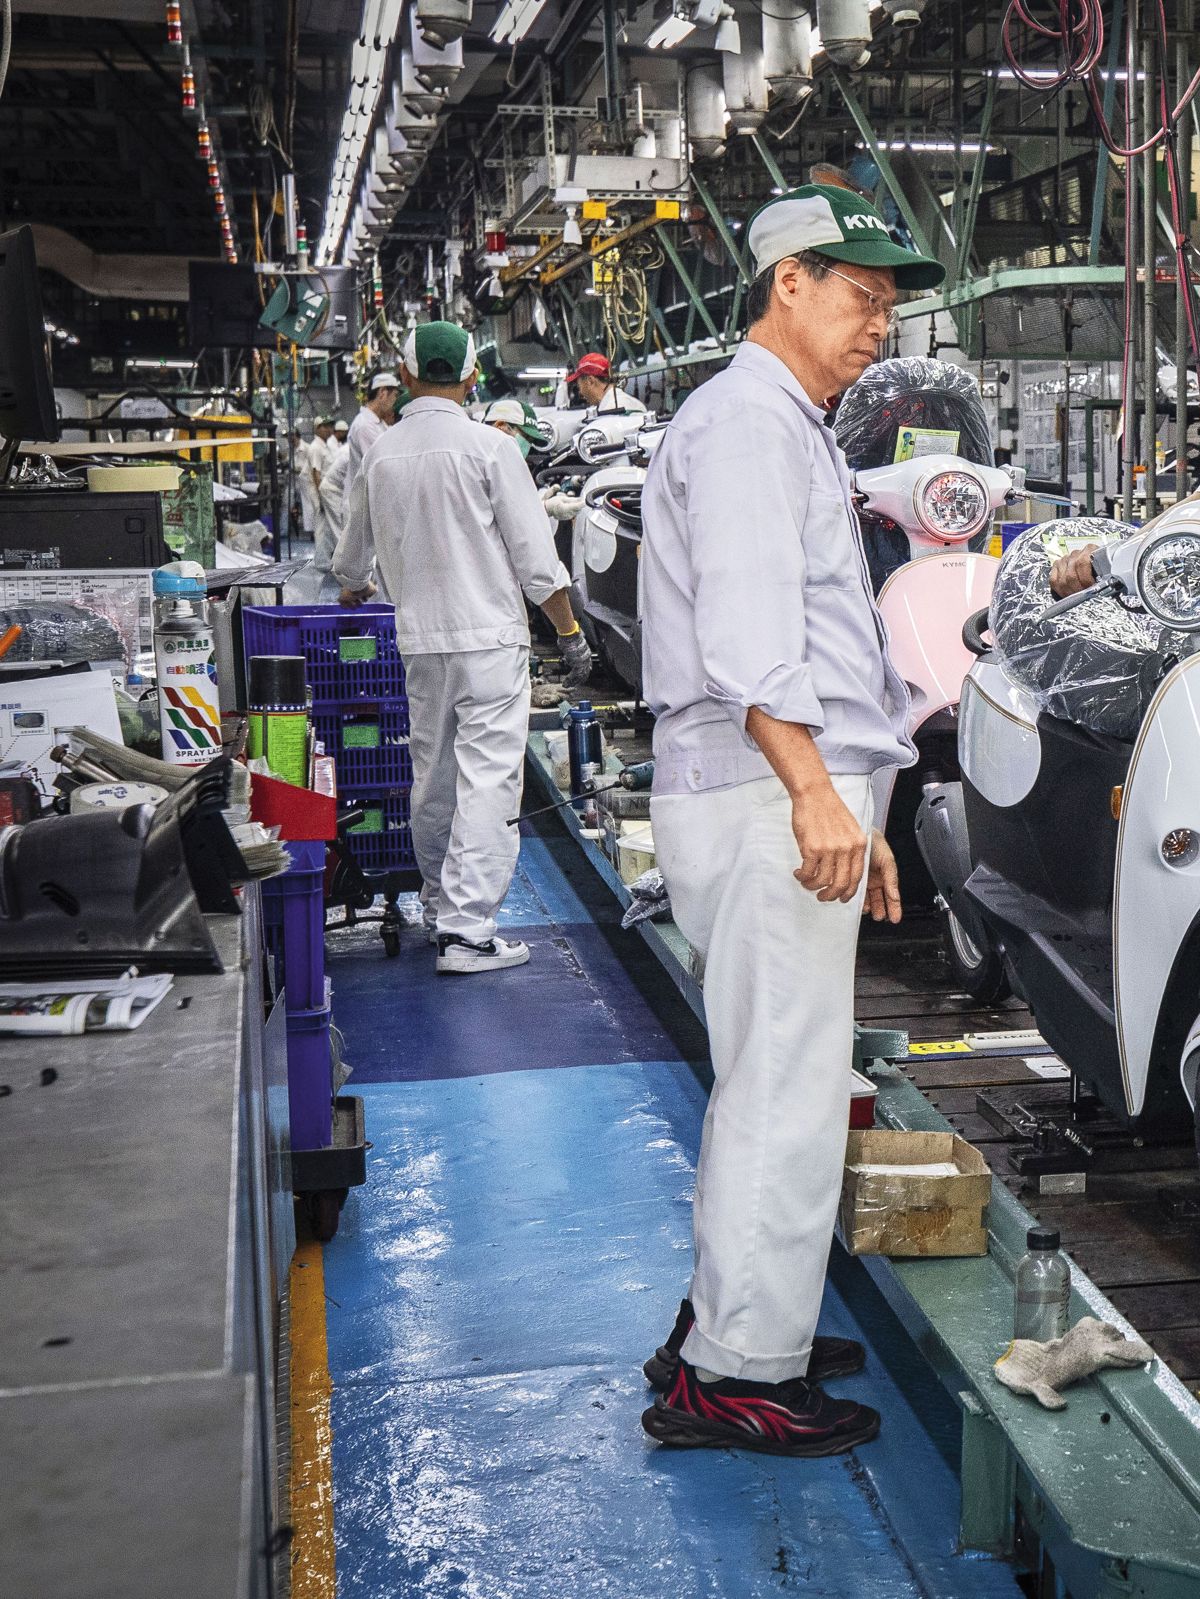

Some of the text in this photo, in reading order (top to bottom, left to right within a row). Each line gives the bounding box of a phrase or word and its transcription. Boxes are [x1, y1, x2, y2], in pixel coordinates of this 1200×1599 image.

[166, 663, 206, 675] 自動噴漆
[175, 750, 206, 758] SPRAY
